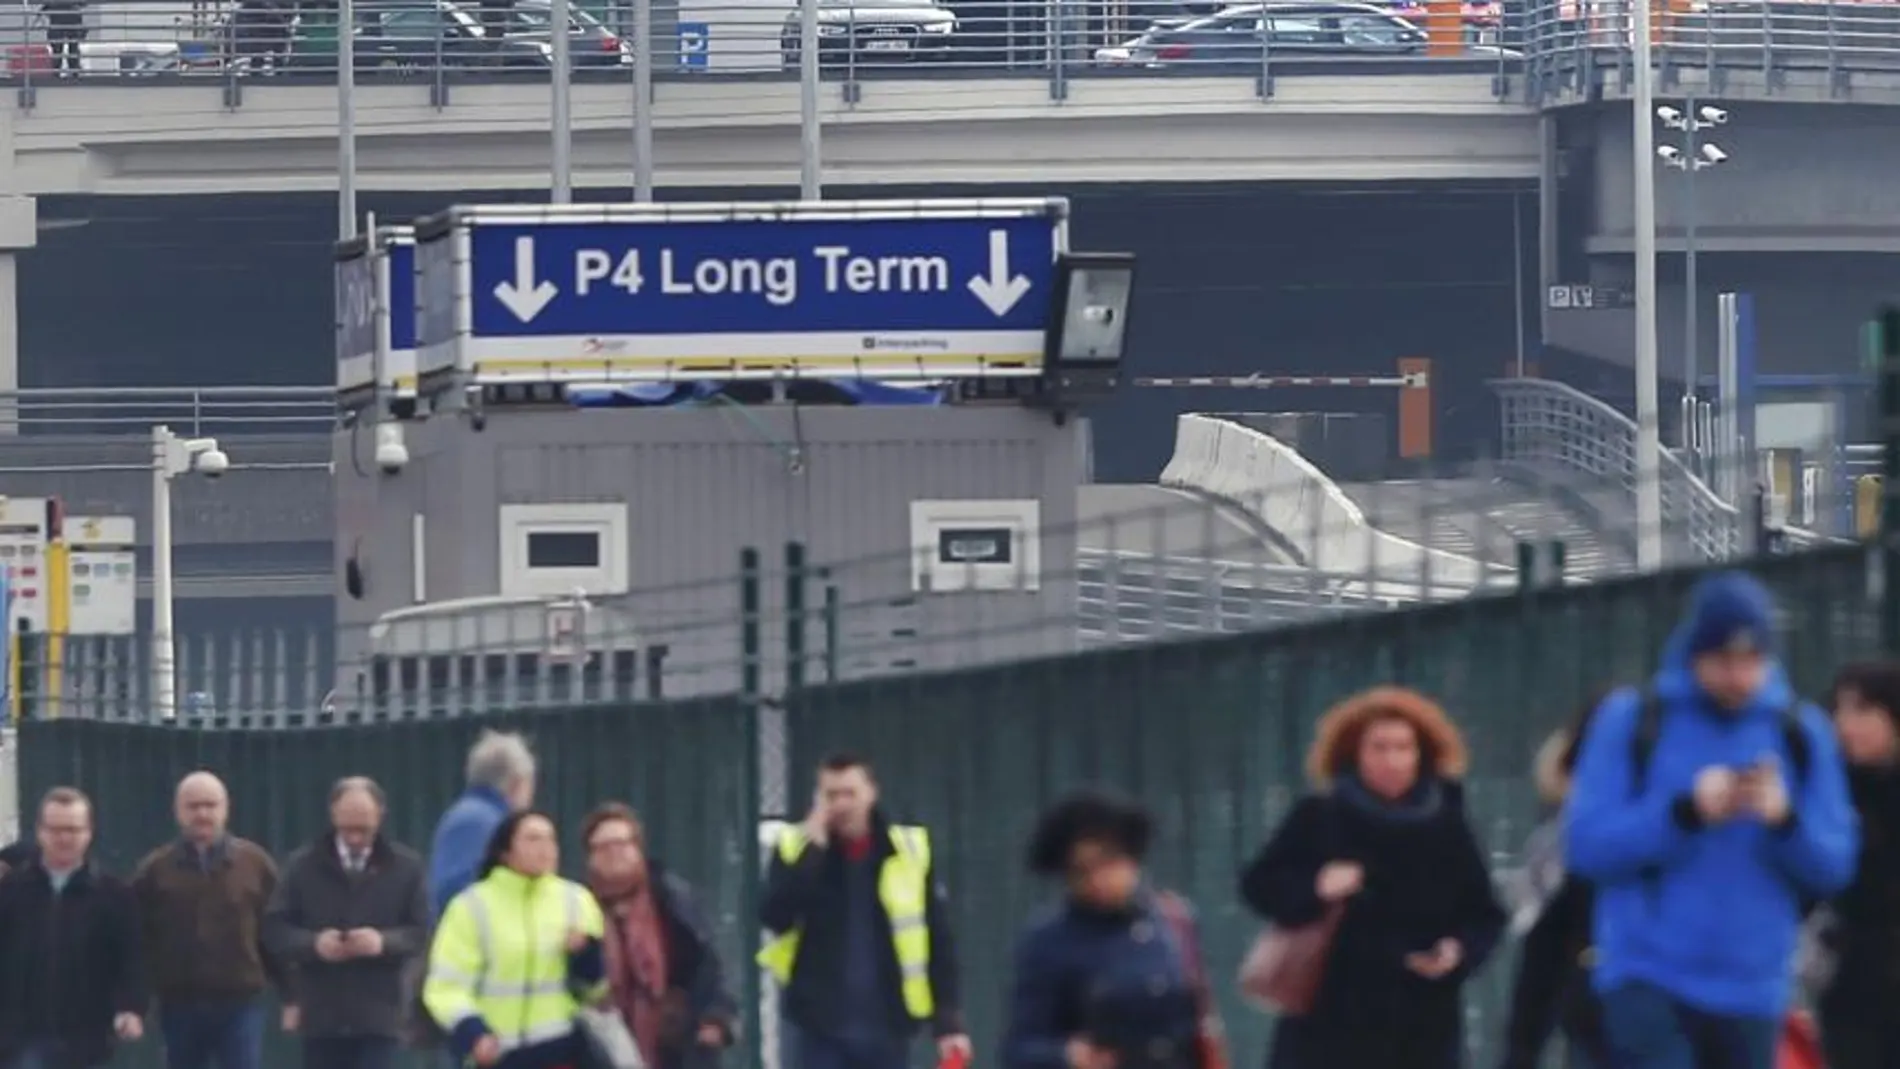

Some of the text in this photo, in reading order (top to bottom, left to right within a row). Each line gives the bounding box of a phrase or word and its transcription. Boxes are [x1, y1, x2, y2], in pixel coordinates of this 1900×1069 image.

[681, 33, 704, 63] P
[575, 246, 948, 305] P4 Long Term
